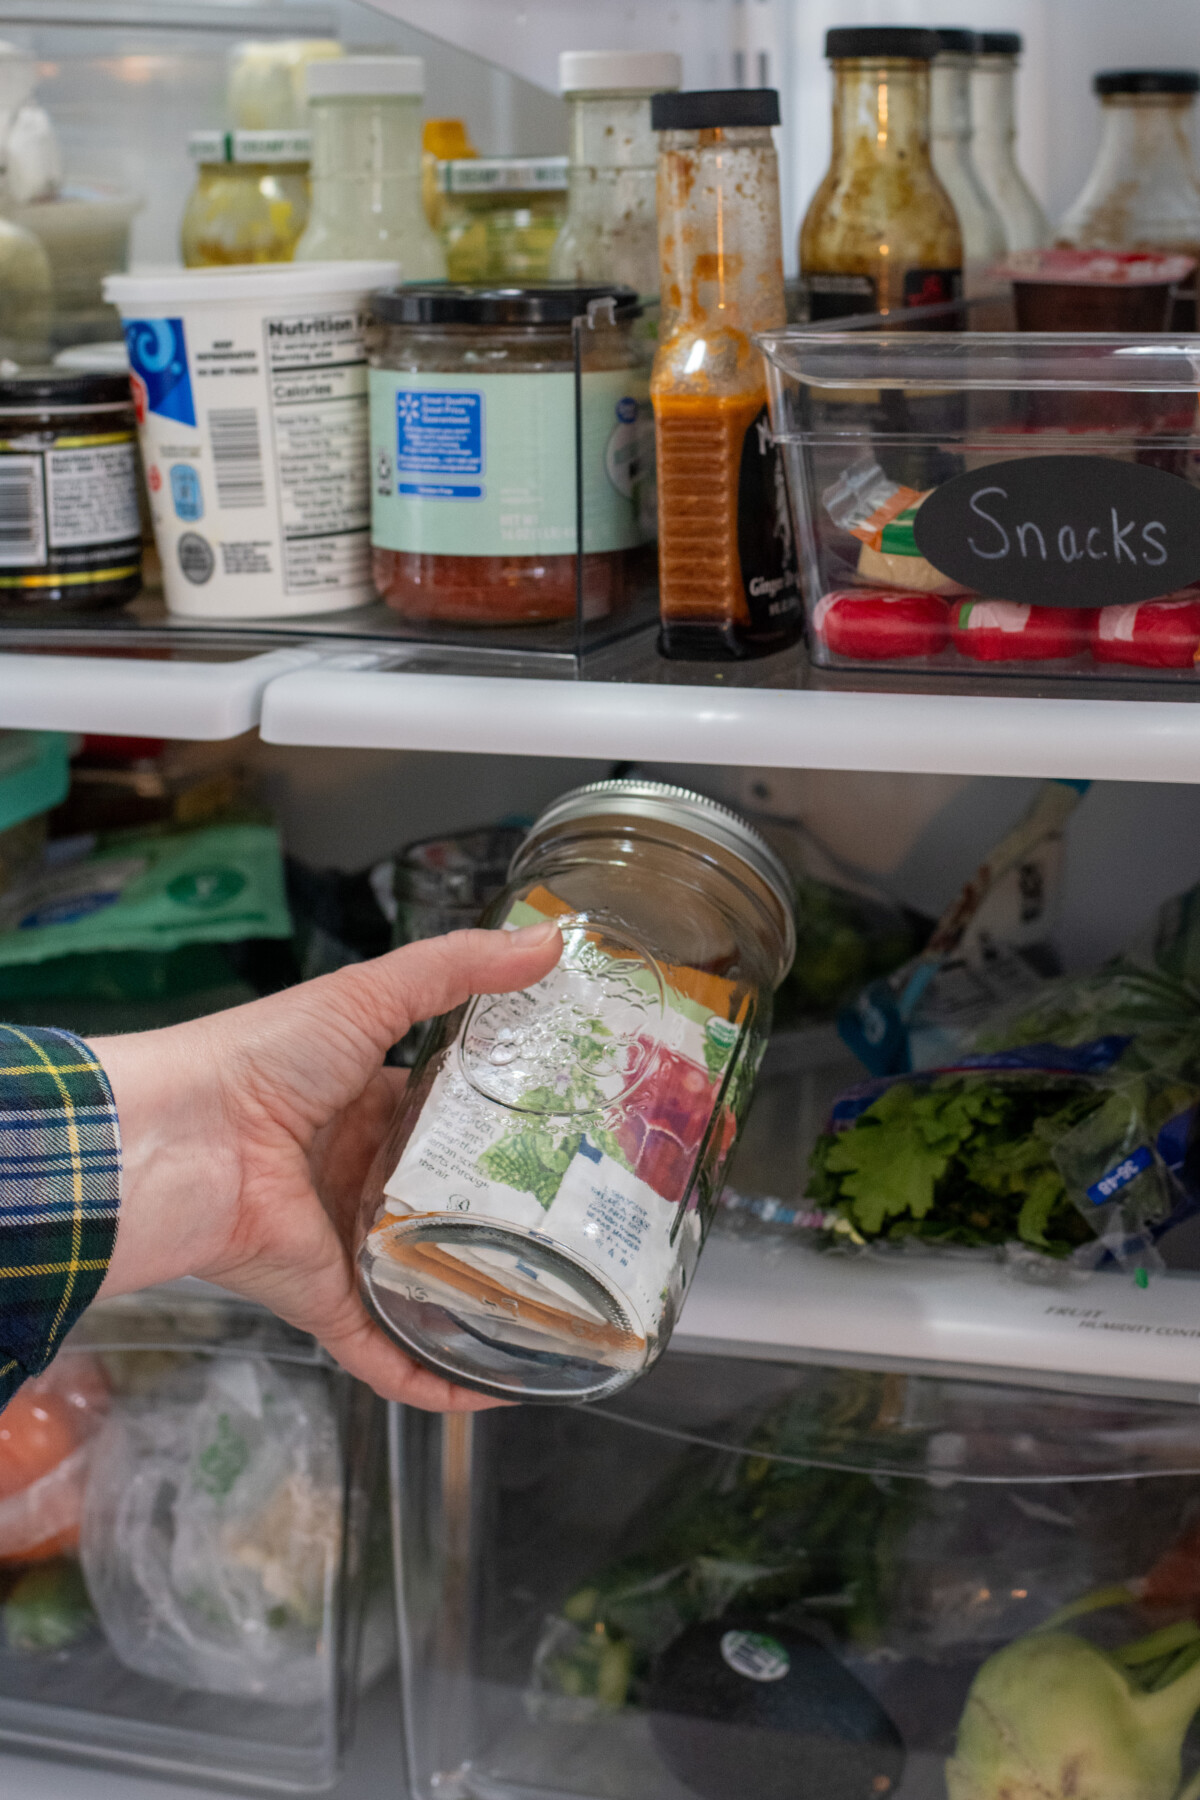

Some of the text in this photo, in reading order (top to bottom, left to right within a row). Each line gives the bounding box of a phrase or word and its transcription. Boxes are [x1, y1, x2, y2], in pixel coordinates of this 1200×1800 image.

[268, 317, 352, 336] Nutrition
[274, 384, 332, 399] Calories
[967, 486, 1168, 566] Snacks
[1097, 1160, 1139, 1196] 36-48
[1045, 1306, 1104, 1319] FRUIT
[1078, 1319, 1152, 1333] HUMIDITY
